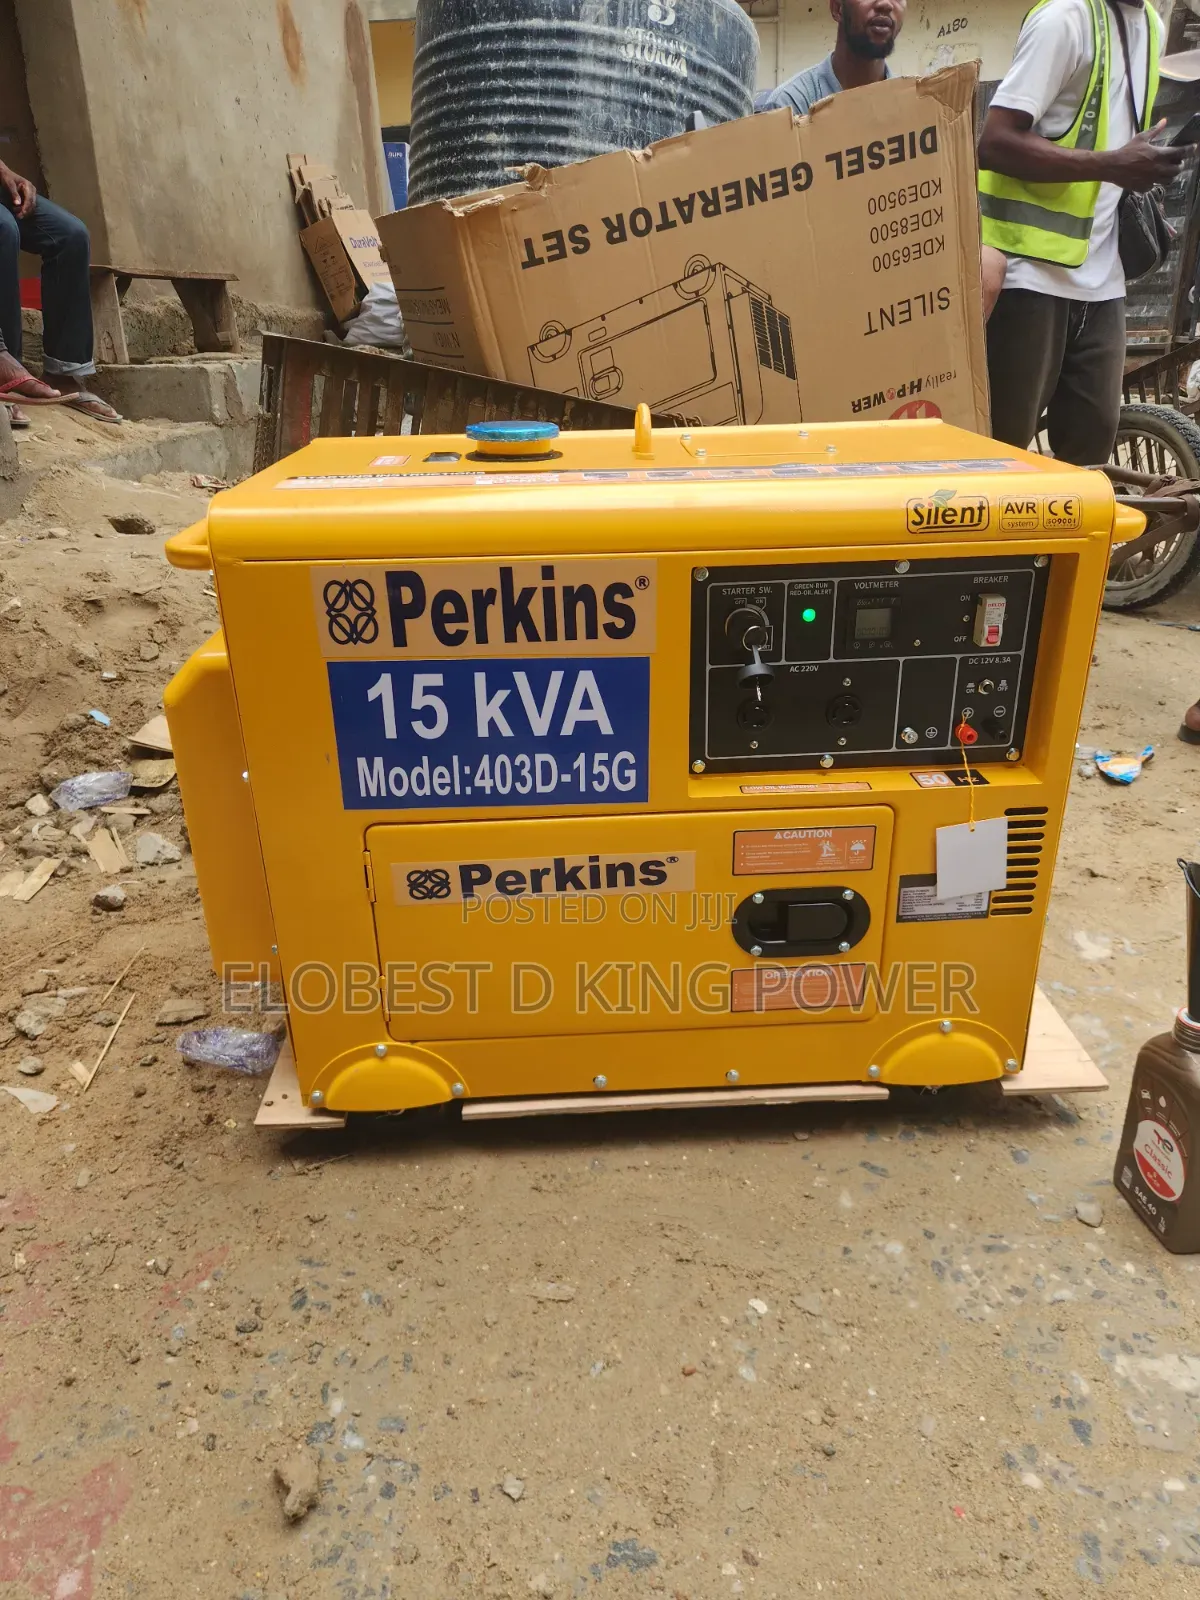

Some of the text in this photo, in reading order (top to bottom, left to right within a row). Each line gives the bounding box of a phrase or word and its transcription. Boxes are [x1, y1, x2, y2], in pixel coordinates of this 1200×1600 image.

[520, 126, 938, 270] DIESEL GENERATOR SET
[868, 177, 942, 215] KDE9500
[870, 206, 944, 244] KDE8500
[872, 235, 945, 272] KDE6500
[864, 286, 950, 336] SILENT
[926, 369, 957, 389] really
[911, 500, 986, 527] Silent
[1004, 502, 1036, 515] AVR
[1047, 500, 1073, 516] CE
[854, 581, 899, 589] VOLTMETER
[973, 575, 1009, 584] BREAKER
[722, 586, 772, 596] STARTER SW.
[953, 635, 967, 643] OFF
[790, 665, 800, 673] AC
[968, 657, 979, 665] DC
[995, 656, 1011, 664] 8.3A
[366, 669, 614, 740] 15 kVA
[356, 750, 637, 798] Model:403D-15G
[917, 773, 949, 786] 50
[783, 829, 833, 840] CAUTION
[1143, 1143, 1173, 1180] Classic
[1134, 1186, 1148, 1201] SAE
[1147, 1202, 1157, 1215] 40
